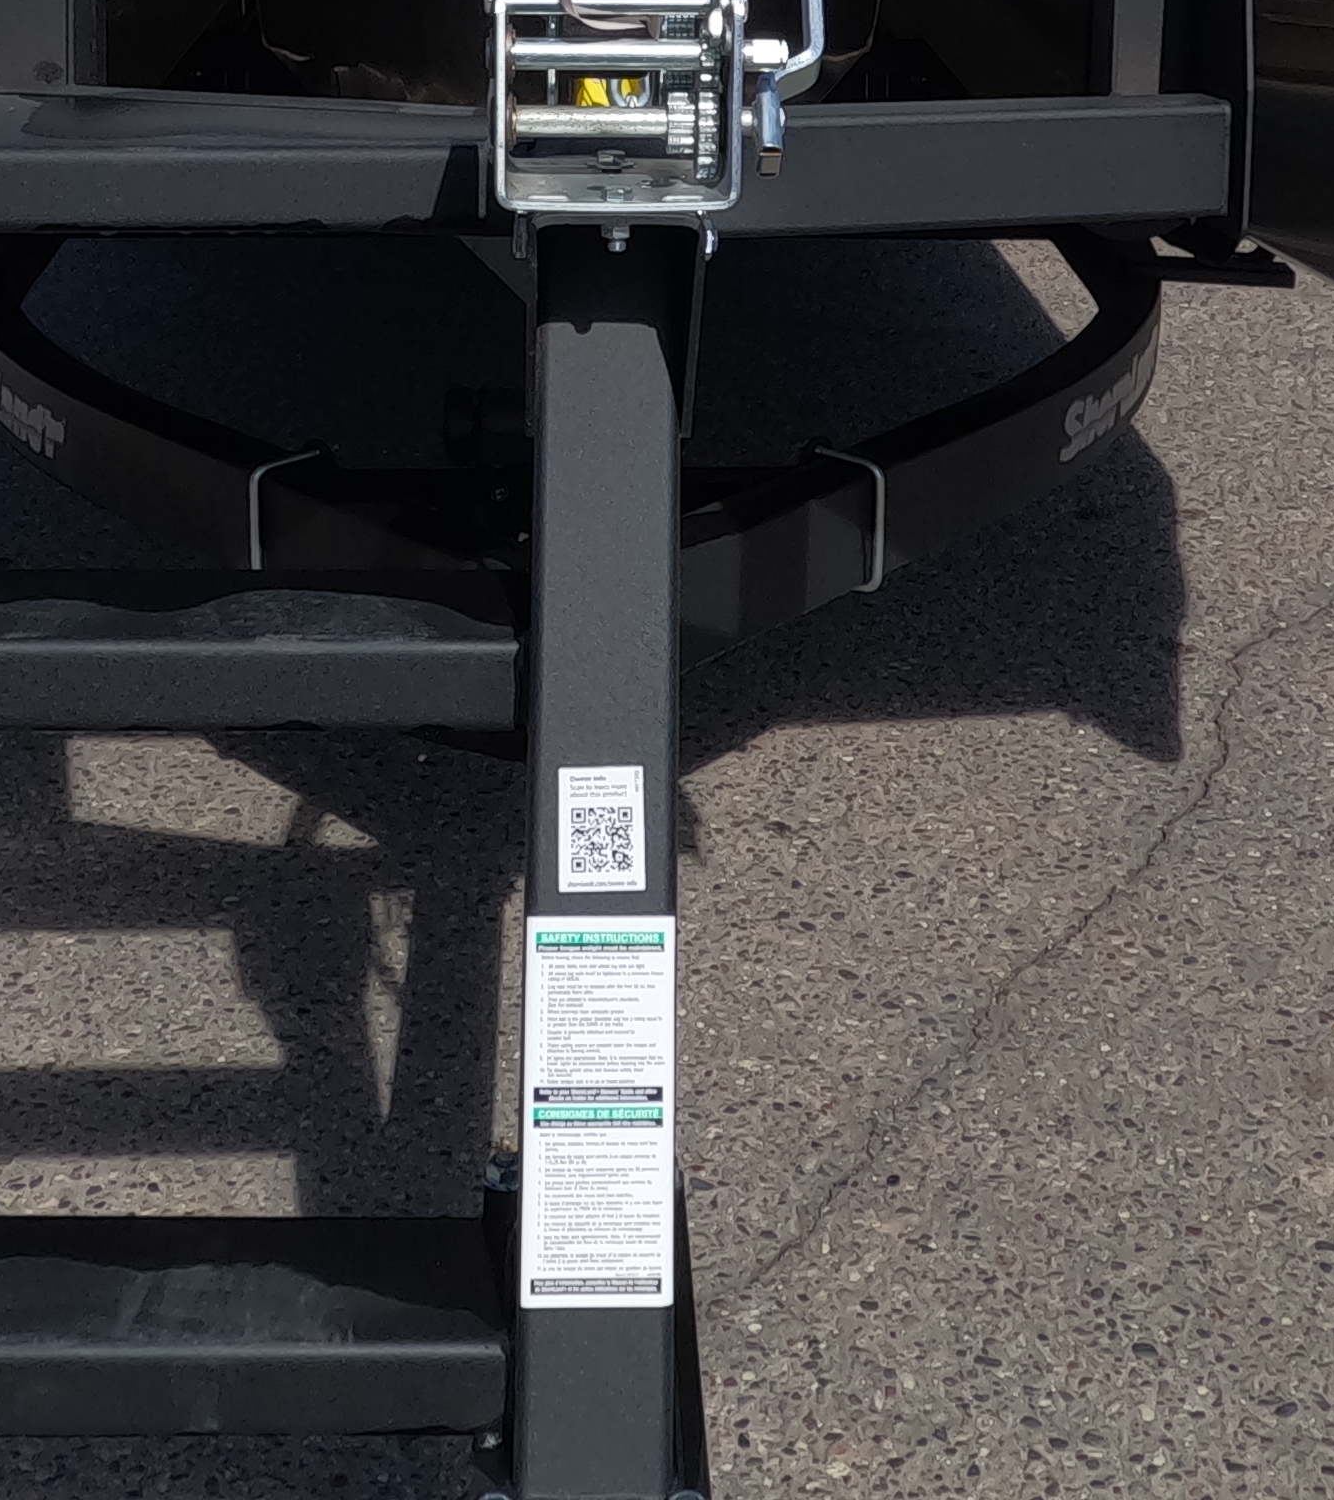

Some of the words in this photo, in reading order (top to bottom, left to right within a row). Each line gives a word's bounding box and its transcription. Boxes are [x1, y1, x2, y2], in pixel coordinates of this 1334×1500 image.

[541, 933, 581, 943] SAFETY
[582, 933, 660, 943] INSTRUCTIONS
[538, 1109, 595, 1119] CONSIGNES
[596, 1109, 610, 1119] DE
[611, 1108, 660, 1119] SÉCURITÉ
